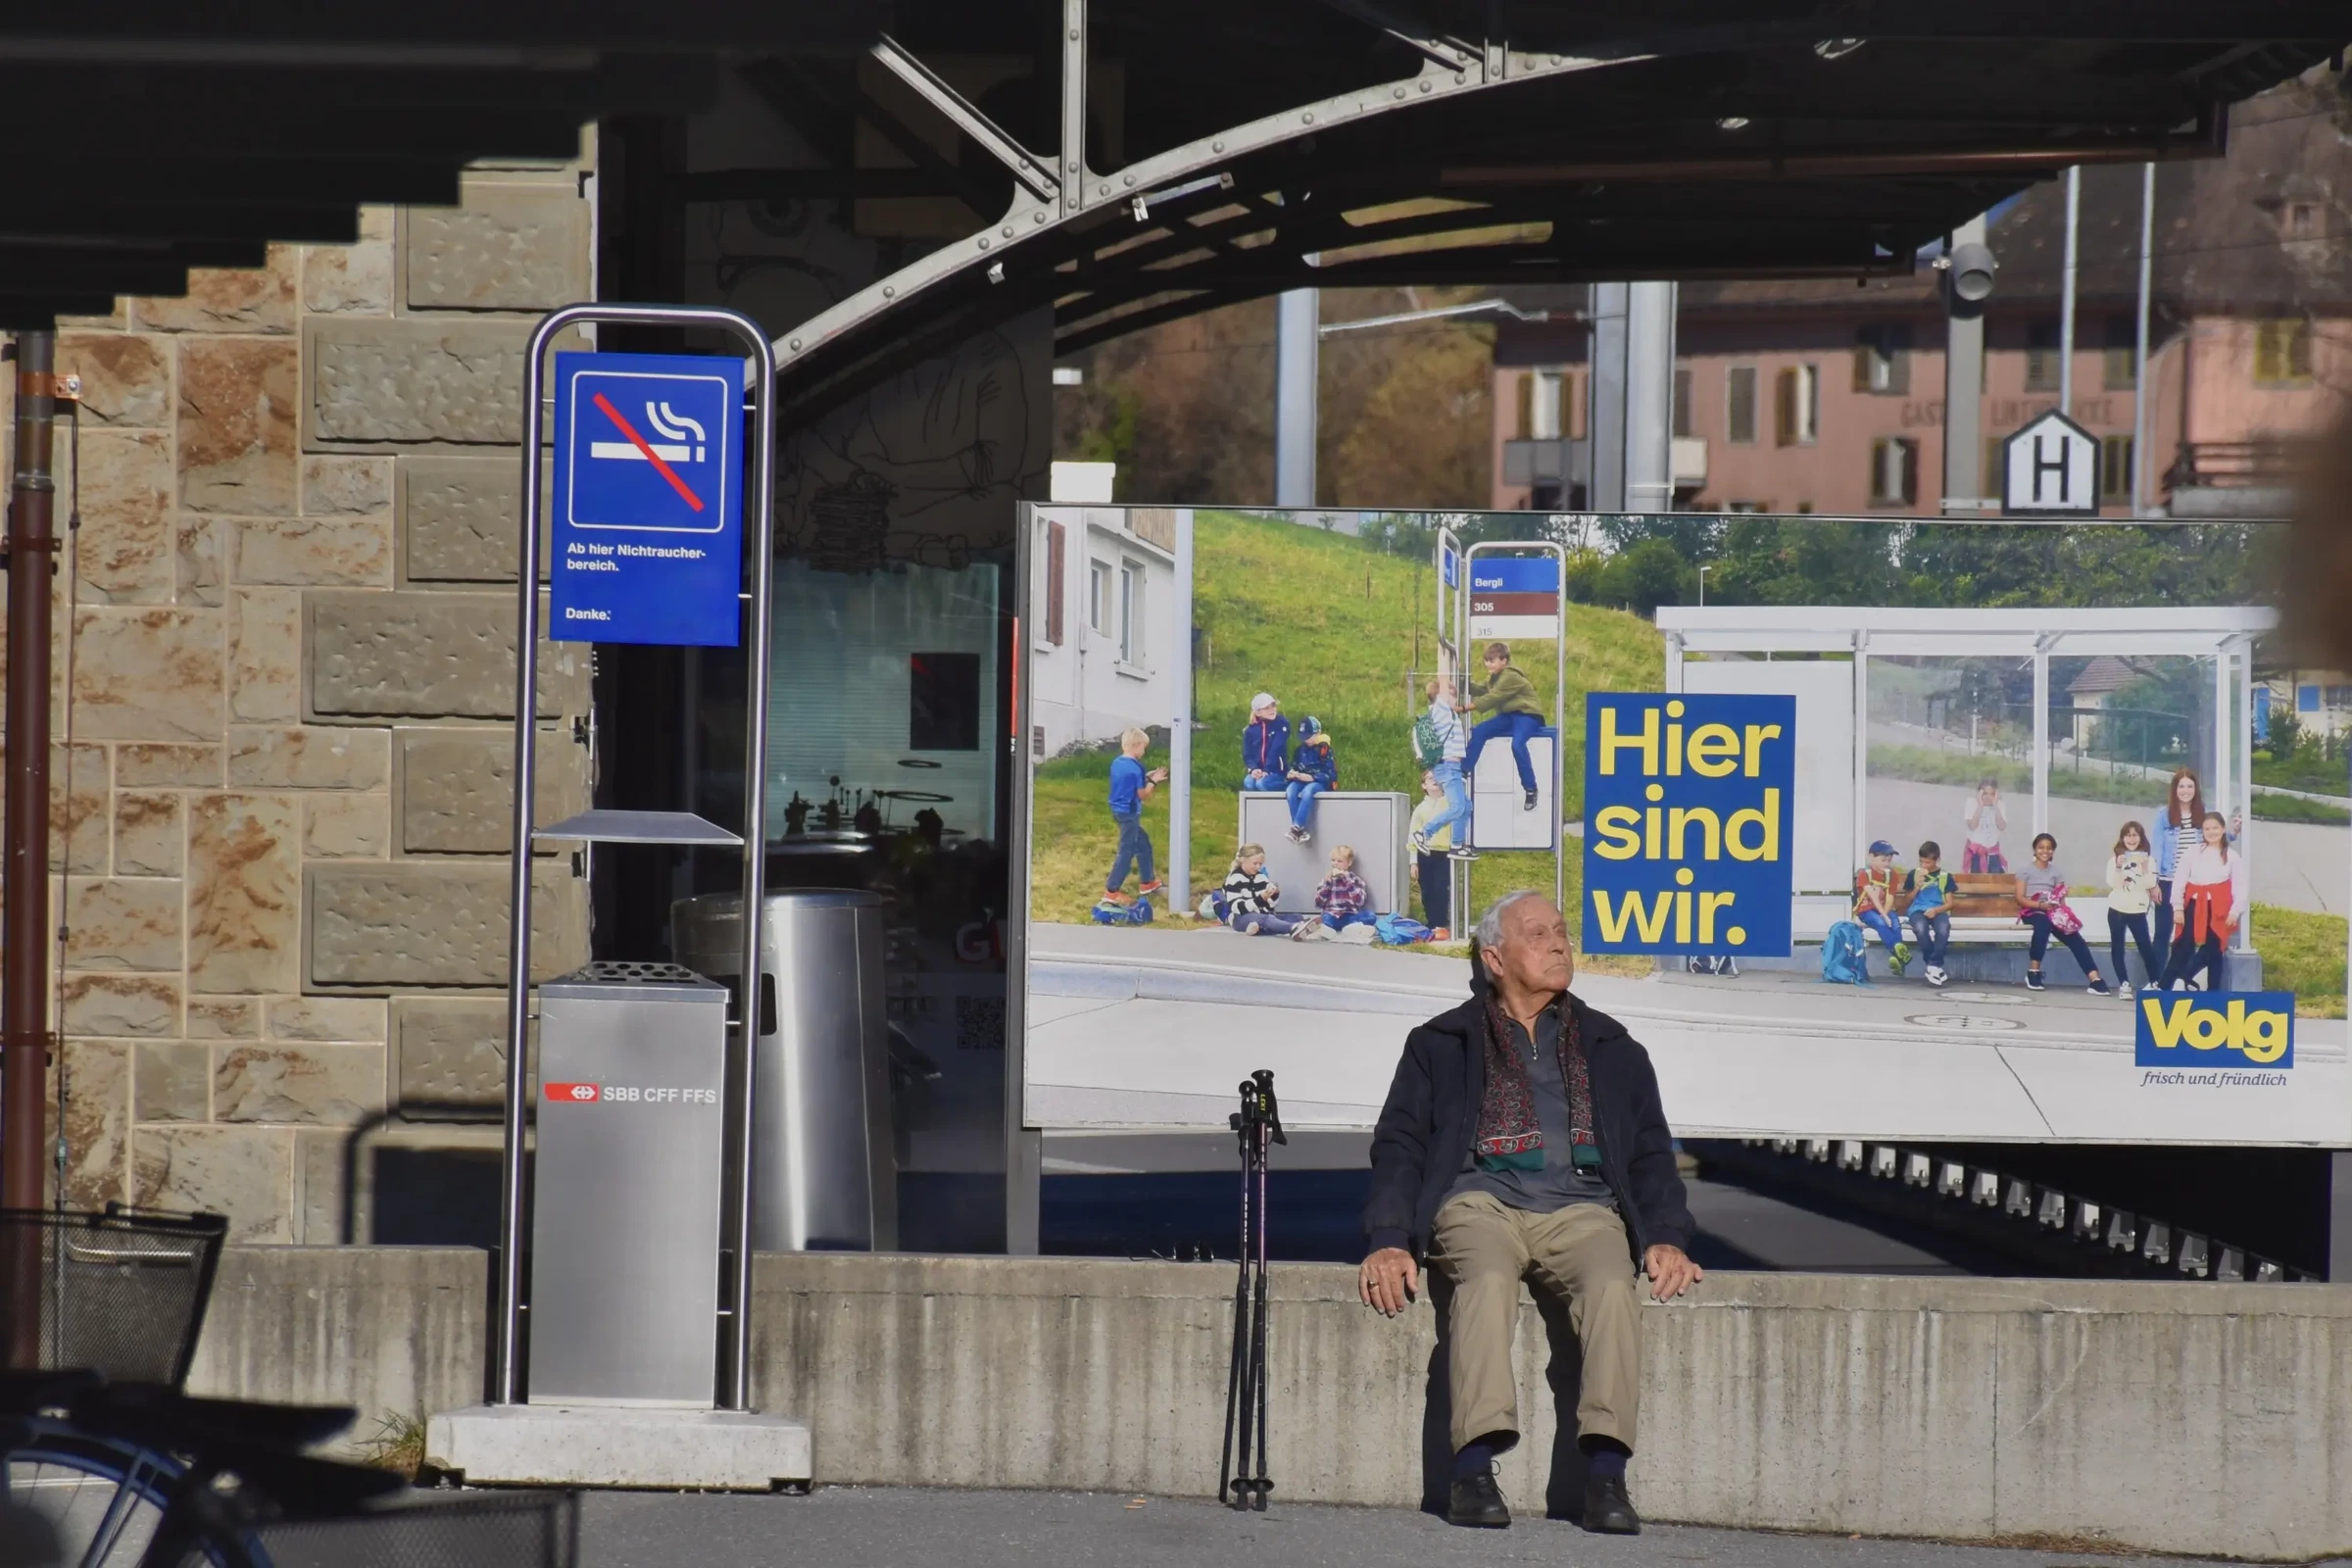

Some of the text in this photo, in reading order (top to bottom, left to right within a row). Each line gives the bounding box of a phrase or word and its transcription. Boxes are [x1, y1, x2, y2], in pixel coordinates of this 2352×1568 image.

[2033, 434, 2070, 503] H
[566, 542, 707, 559] Ab hier Nichtraucher-
[566, 558, 619, 571] bereich.
[1474, 577, 1503, 589] Bergli
[1474, 602, 1494, 612] 305
[1477, 627, 1493, 637] 315
[1599, 700, 1782, 778] Hier
[1593, 783, 1780, 861] sind
[1592, 867, 1746, 946] wir.
[2142, 998, 2288, 1063] Volg
[2140, 1071, 2287, 1089] frisch und fründlich
[603, 1086, 716, 1103] SBB CFF FFS
